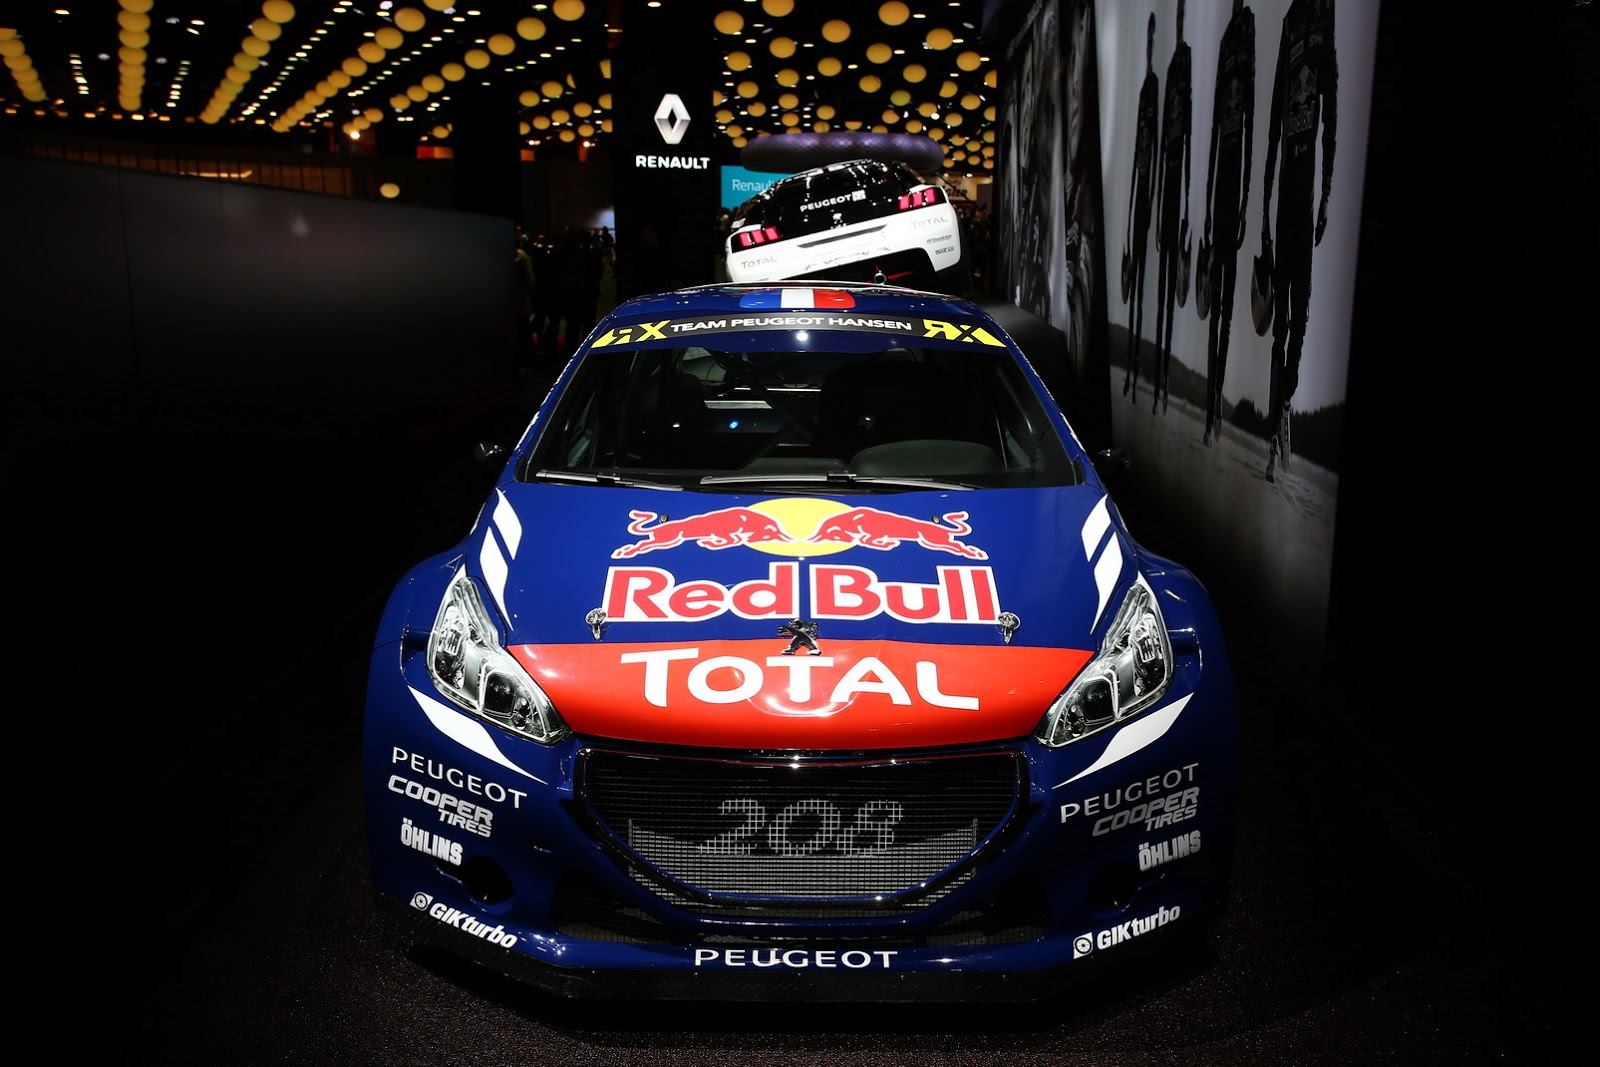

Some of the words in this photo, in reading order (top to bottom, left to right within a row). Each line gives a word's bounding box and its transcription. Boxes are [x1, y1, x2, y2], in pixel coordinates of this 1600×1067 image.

[635, 155, 710, 169] RENAULT
[800, 193, 852, 212] PEUGEOT
[741, 256, 778, 269] TOTAL
[670, 319, 727, 333] TEAM
[731, 316, 824, 328] PEUGEOT
[828, 317, 912, 331] HANSEN
[604, 562, 799, 621] Red
[811, 563, 1000, 623] Bull
[620, 647, 979, 710] TOTAL
[391, 746, 527, 809] PEUGEOT
[1060, 762, 1199, 824] PEUGEOT
[388, 774, 493, 827] COOPER
[438, 807, 493, 838] TIRES
[1092, 786, 1200, 837] COOPER
[1144, 803, 1198, 832] TIRES
[400, 817, 463, 866] ÖHLINS
[700, 798, 903, 858] 208
[1138, 830, 1200, 872] ÖHLINS
[694, 948, 898, 969] PEUGEOT
